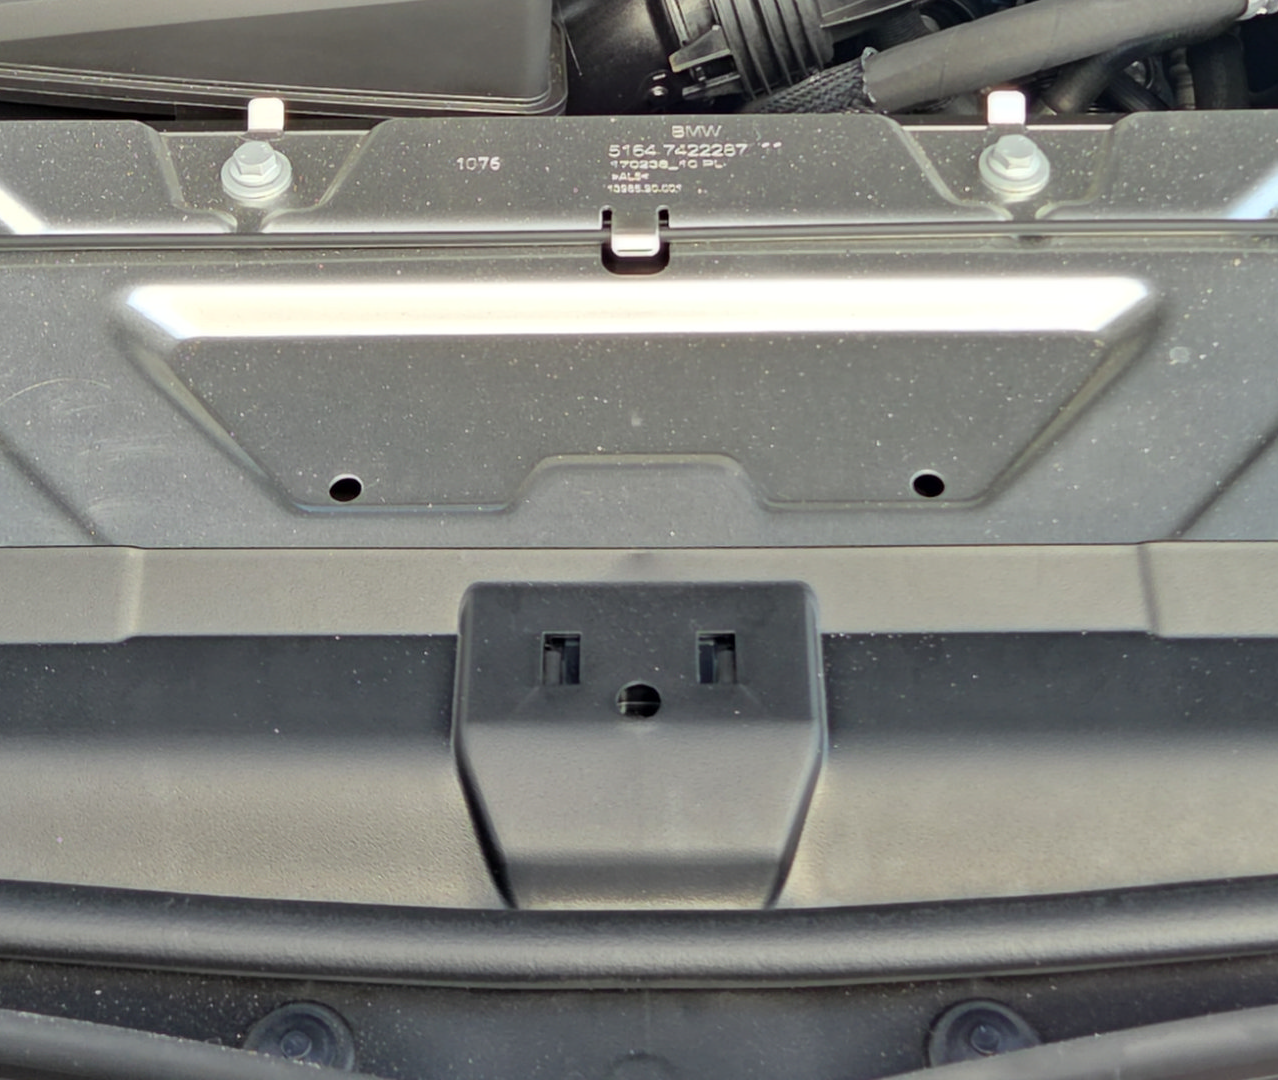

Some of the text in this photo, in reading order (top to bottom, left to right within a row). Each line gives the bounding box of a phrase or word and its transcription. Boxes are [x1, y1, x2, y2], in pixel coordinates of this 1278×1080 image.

[671, 125, 722, 138] BMW
[608, 144, 657, 158] 5164
[663, 143, 748, 157] 7422287
[455, 156, 501, 171] 1076
